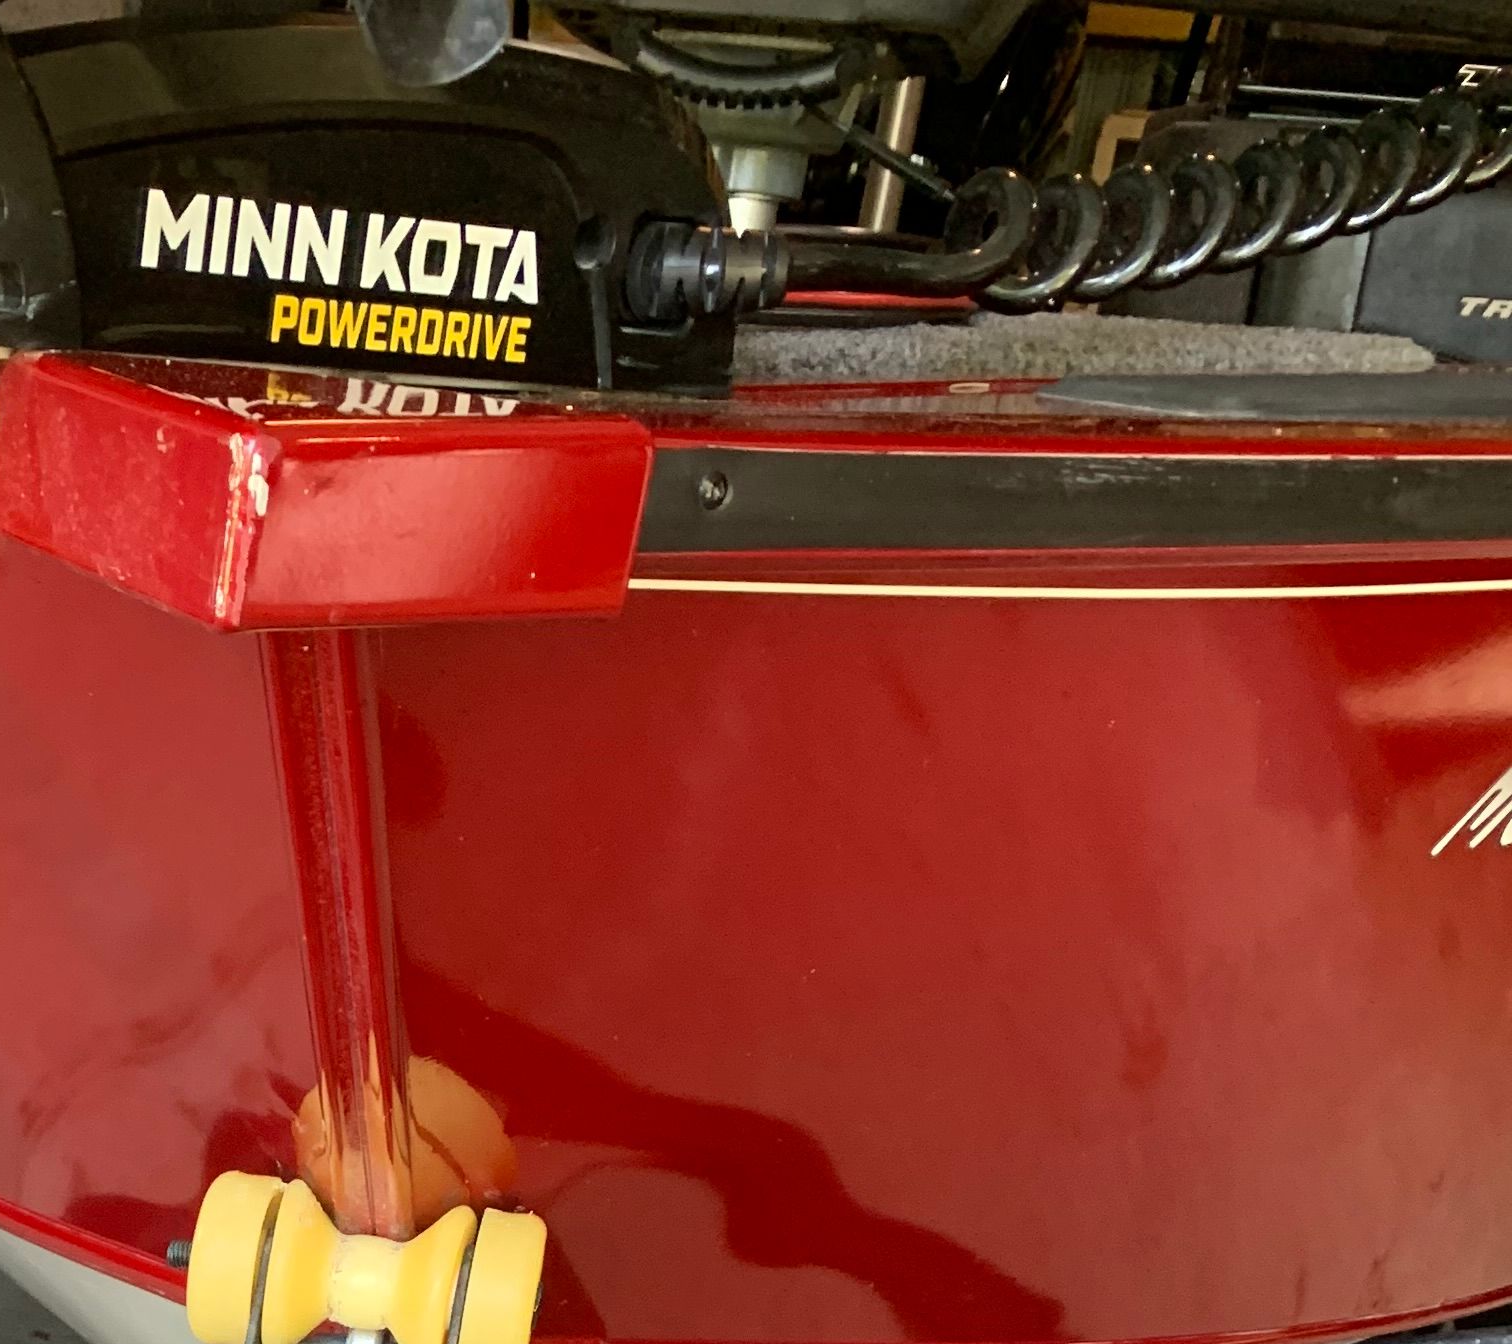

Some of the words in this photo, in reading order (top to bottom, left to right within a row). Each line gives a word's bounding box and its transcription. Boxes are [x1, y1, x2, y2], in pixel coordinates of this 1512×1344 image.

[140, 188, 348, 286] MINN
[360, 213, 540, 305] KOTA
[271, 294, 532, 364] POWERDRIVE
